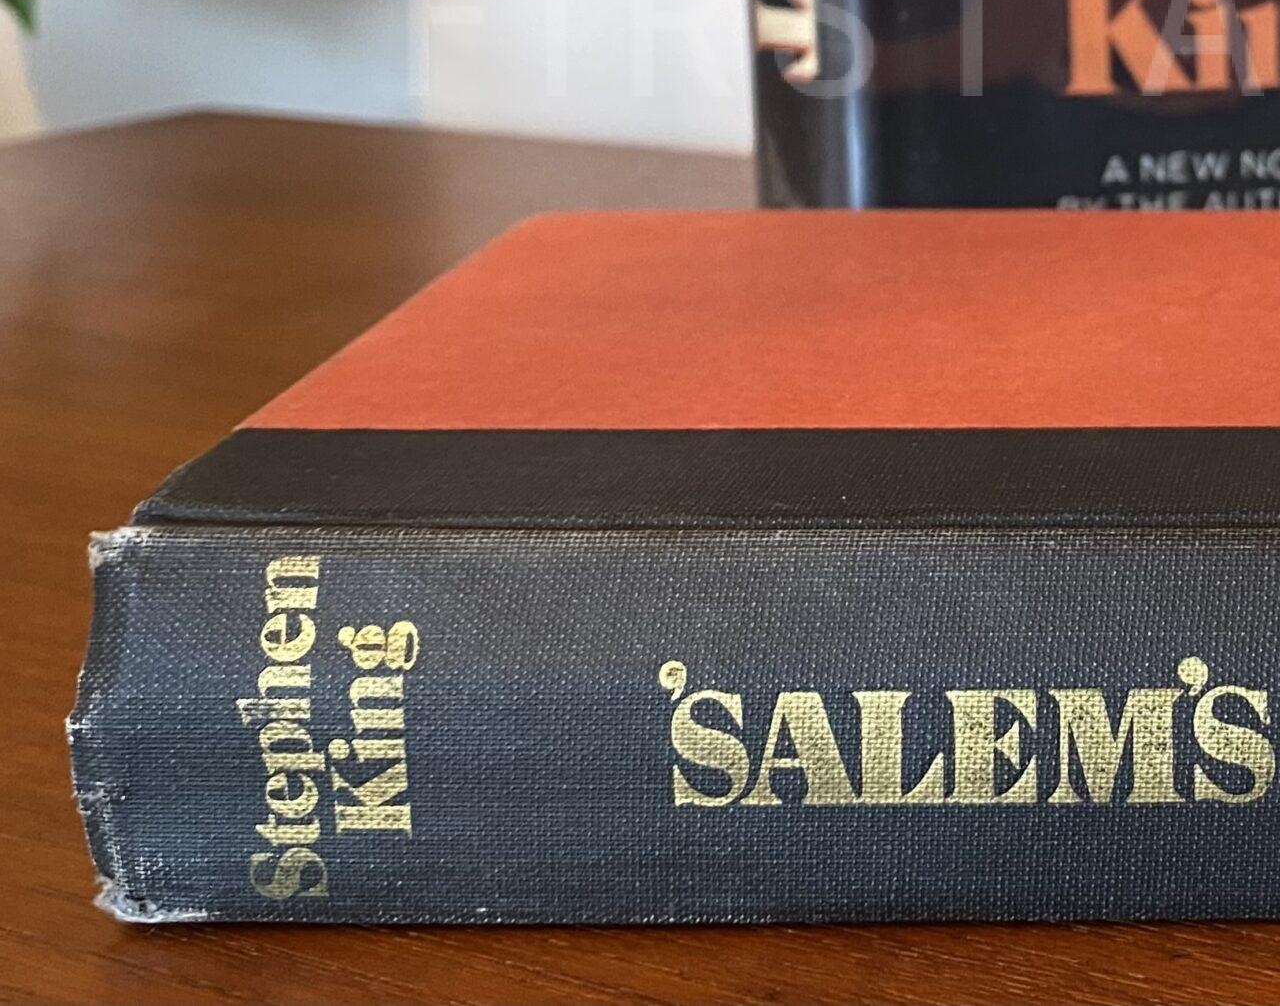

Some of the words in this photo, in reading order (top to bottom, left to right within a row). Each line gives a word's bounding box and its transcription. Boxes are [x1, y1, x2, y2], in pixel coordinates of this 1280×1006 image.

[1101, 153, 1129, 184] A
[1138, 149, 1231, 184] NEW
[236, 555, 329, 899] Stephen
[328, 620, 420, 839] King
[658, 656, 1277, 809] 'SALEM'S
